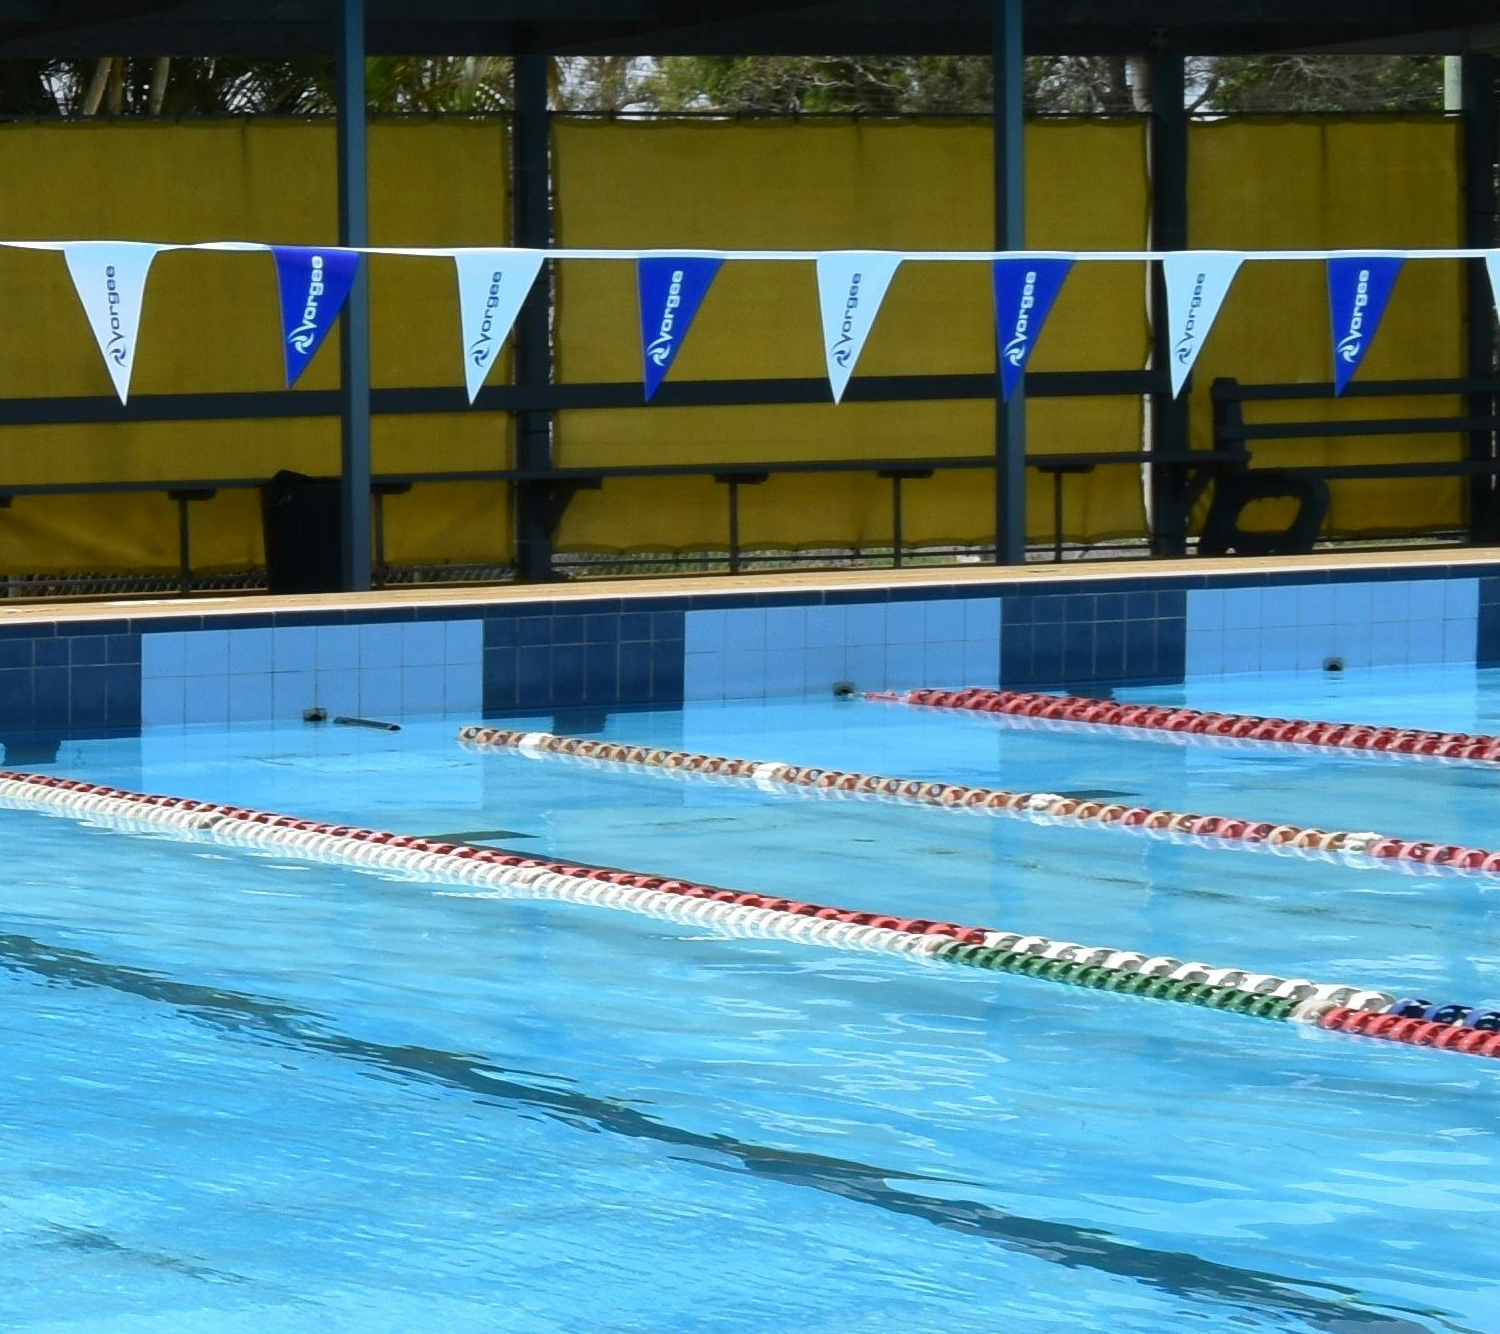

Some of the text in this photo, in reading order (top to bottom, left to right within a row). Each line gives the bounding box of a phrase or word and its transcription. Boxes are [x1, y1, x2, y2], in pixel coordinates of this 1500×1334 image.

[105, 265, 125, 349] vorgee
[287, 255, 324, 340] vorgee
[469, 271, 503, 351] vorgee
[647, 270, 683, 351] vorgee
[831, 272, 862, 351] vorgee
[1004, 271, 1037, 351] vorgee
[1172, 273, 1205, 349] vorgee
[1338, 269, 1370, 350] vorgee
